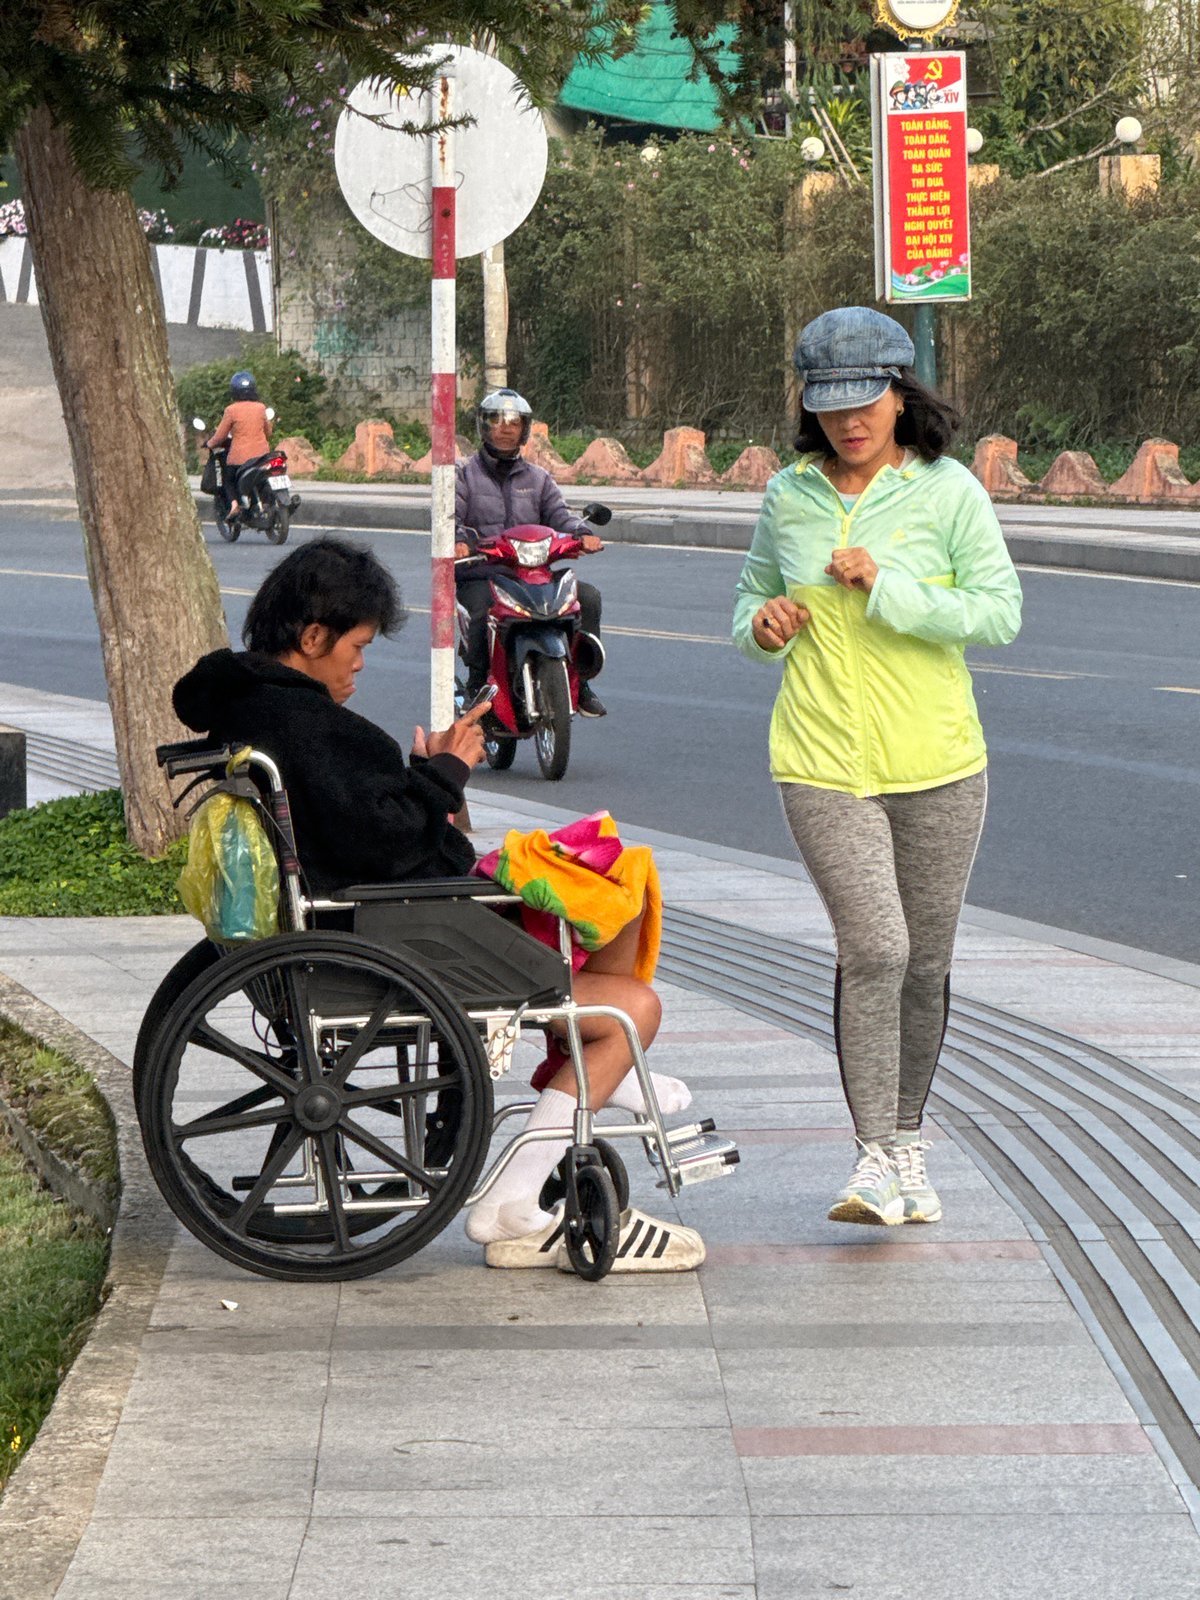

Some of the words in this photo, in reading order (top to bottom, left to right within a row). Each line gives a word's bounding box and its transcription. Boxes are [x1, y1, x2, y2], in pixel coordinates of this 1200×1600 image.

[944, 91, 959, 104] XIV
[911, 163, 924, 174] RA
[911, 178, 925, 188] THI
[939, 234, 953, 244] XIV
